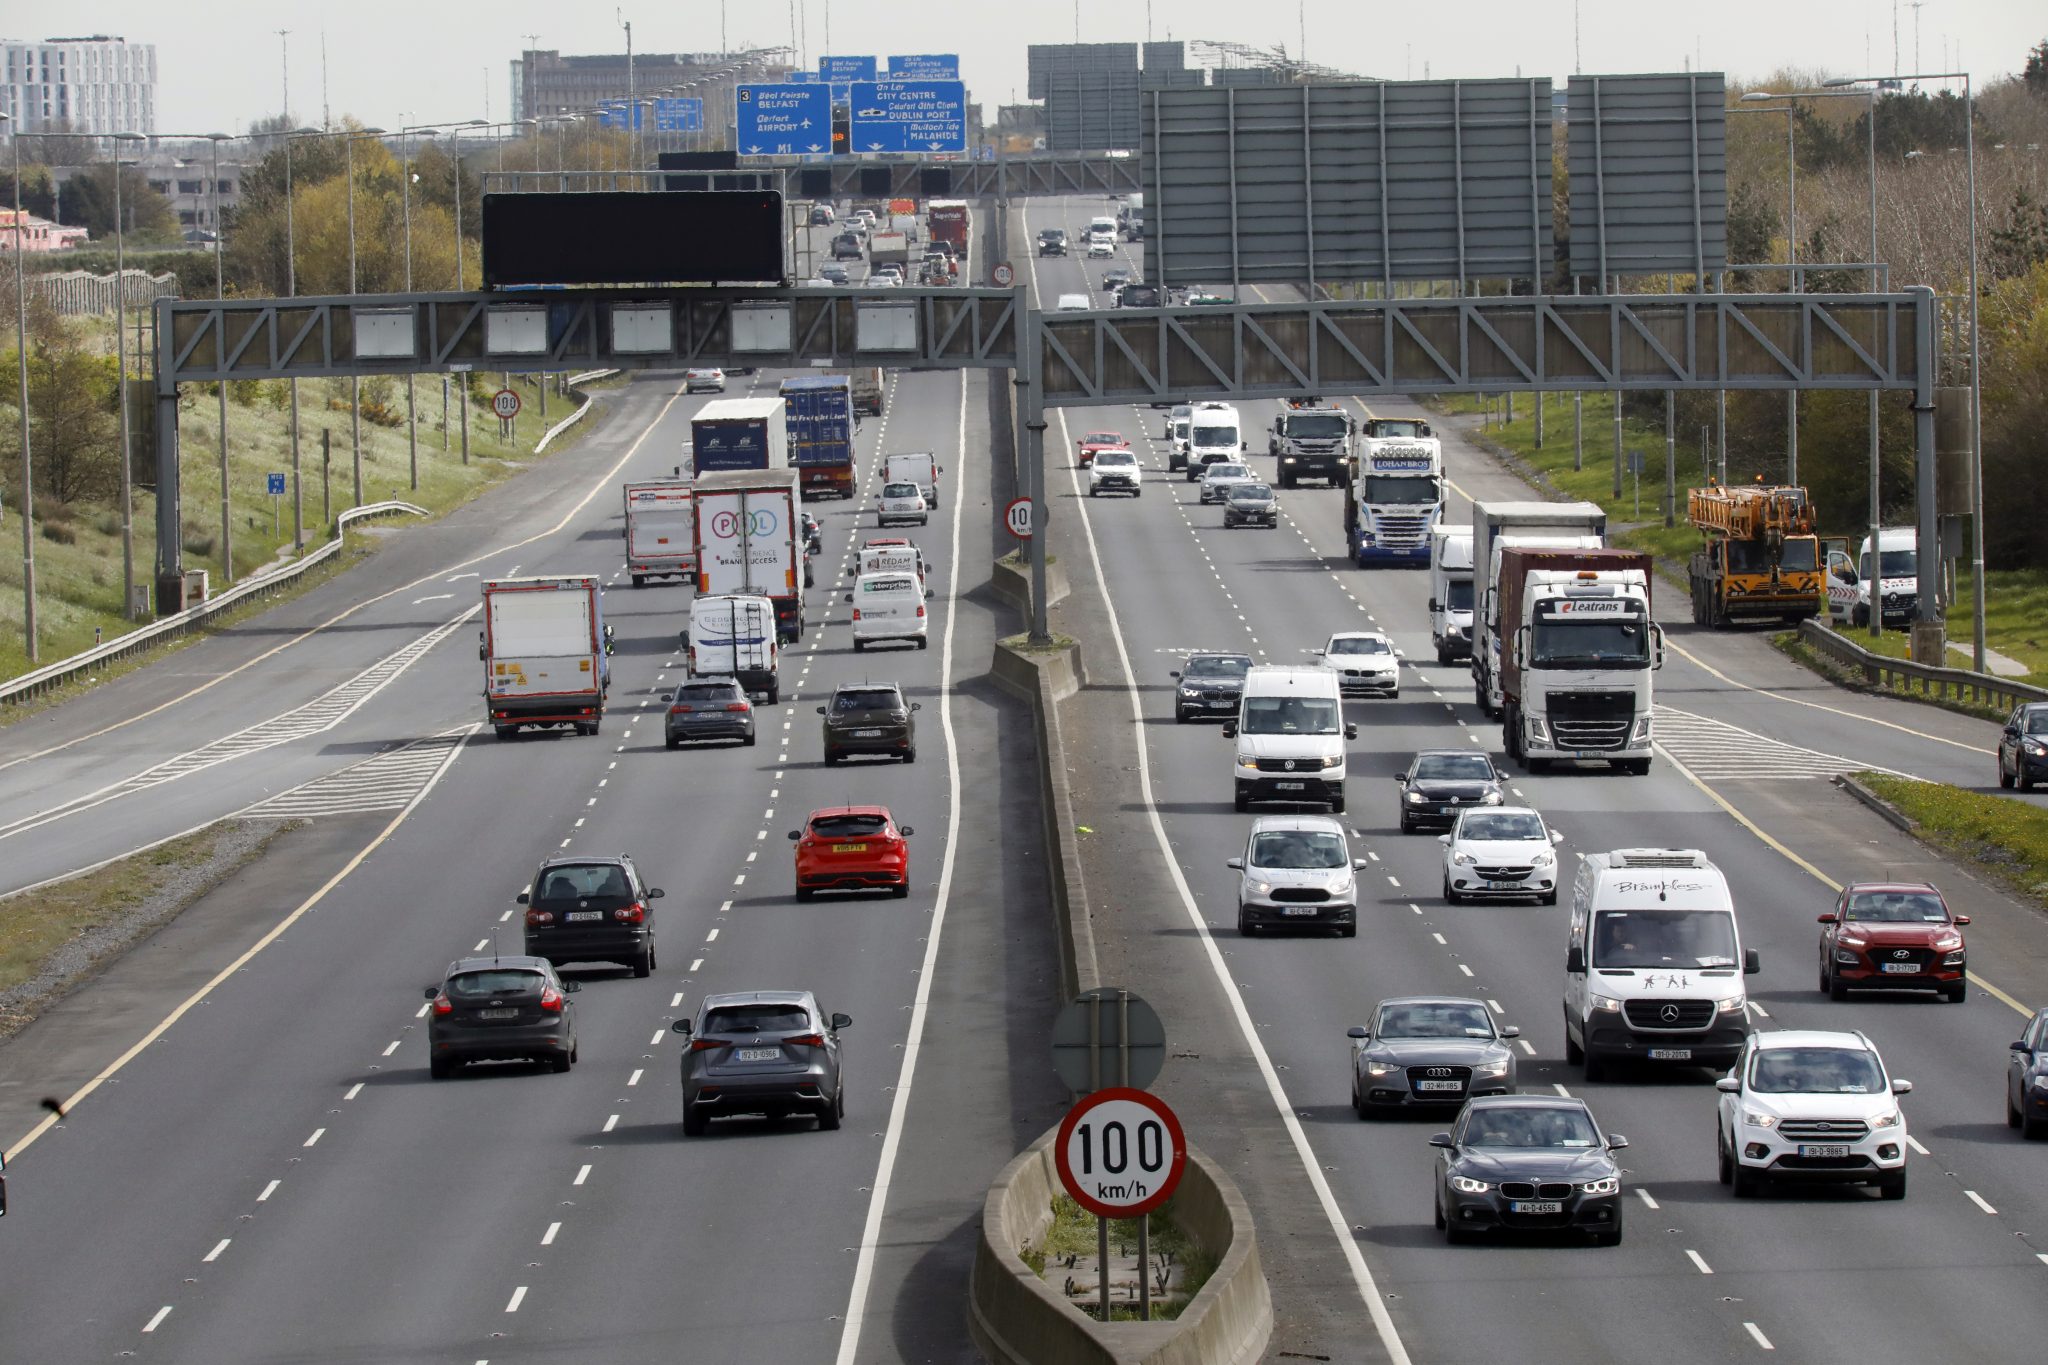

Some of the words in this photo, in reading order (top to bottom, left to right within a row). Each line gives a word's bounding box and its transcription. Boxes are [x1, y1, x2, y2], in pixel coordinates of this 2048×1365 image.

[741, 91, 750, 101] 3
[877, 92, 897, 100] CITY
[899, 91, 936, 100] CENTRE
[889, 111, 923, 119] DUBLIN
[926, 111, 951, 119] PORT
[757, 124, 798, 132] AIRPORT
[910, 131, 958, 140] MALAHIDE
[777, 143, 792, 153] M1
[496, 397, 516, 409] 100
[1377, 460, 1407, 468] LOHAN
[1408, 460, 1428, 468] BROS
[1011, 508, 1033, 525] 10
[864, 581, 911, 590] enterprise
[1571, 600, 1619, 612] Leatrans
[1078, 1120, 1163, 1174] 100
[1808, 1147, 1844, 1156] 191-D-9885
[1098, 1179, 1147, 1200] km/h
[1520, 1203, 1556, 1212] 141-D-4556
